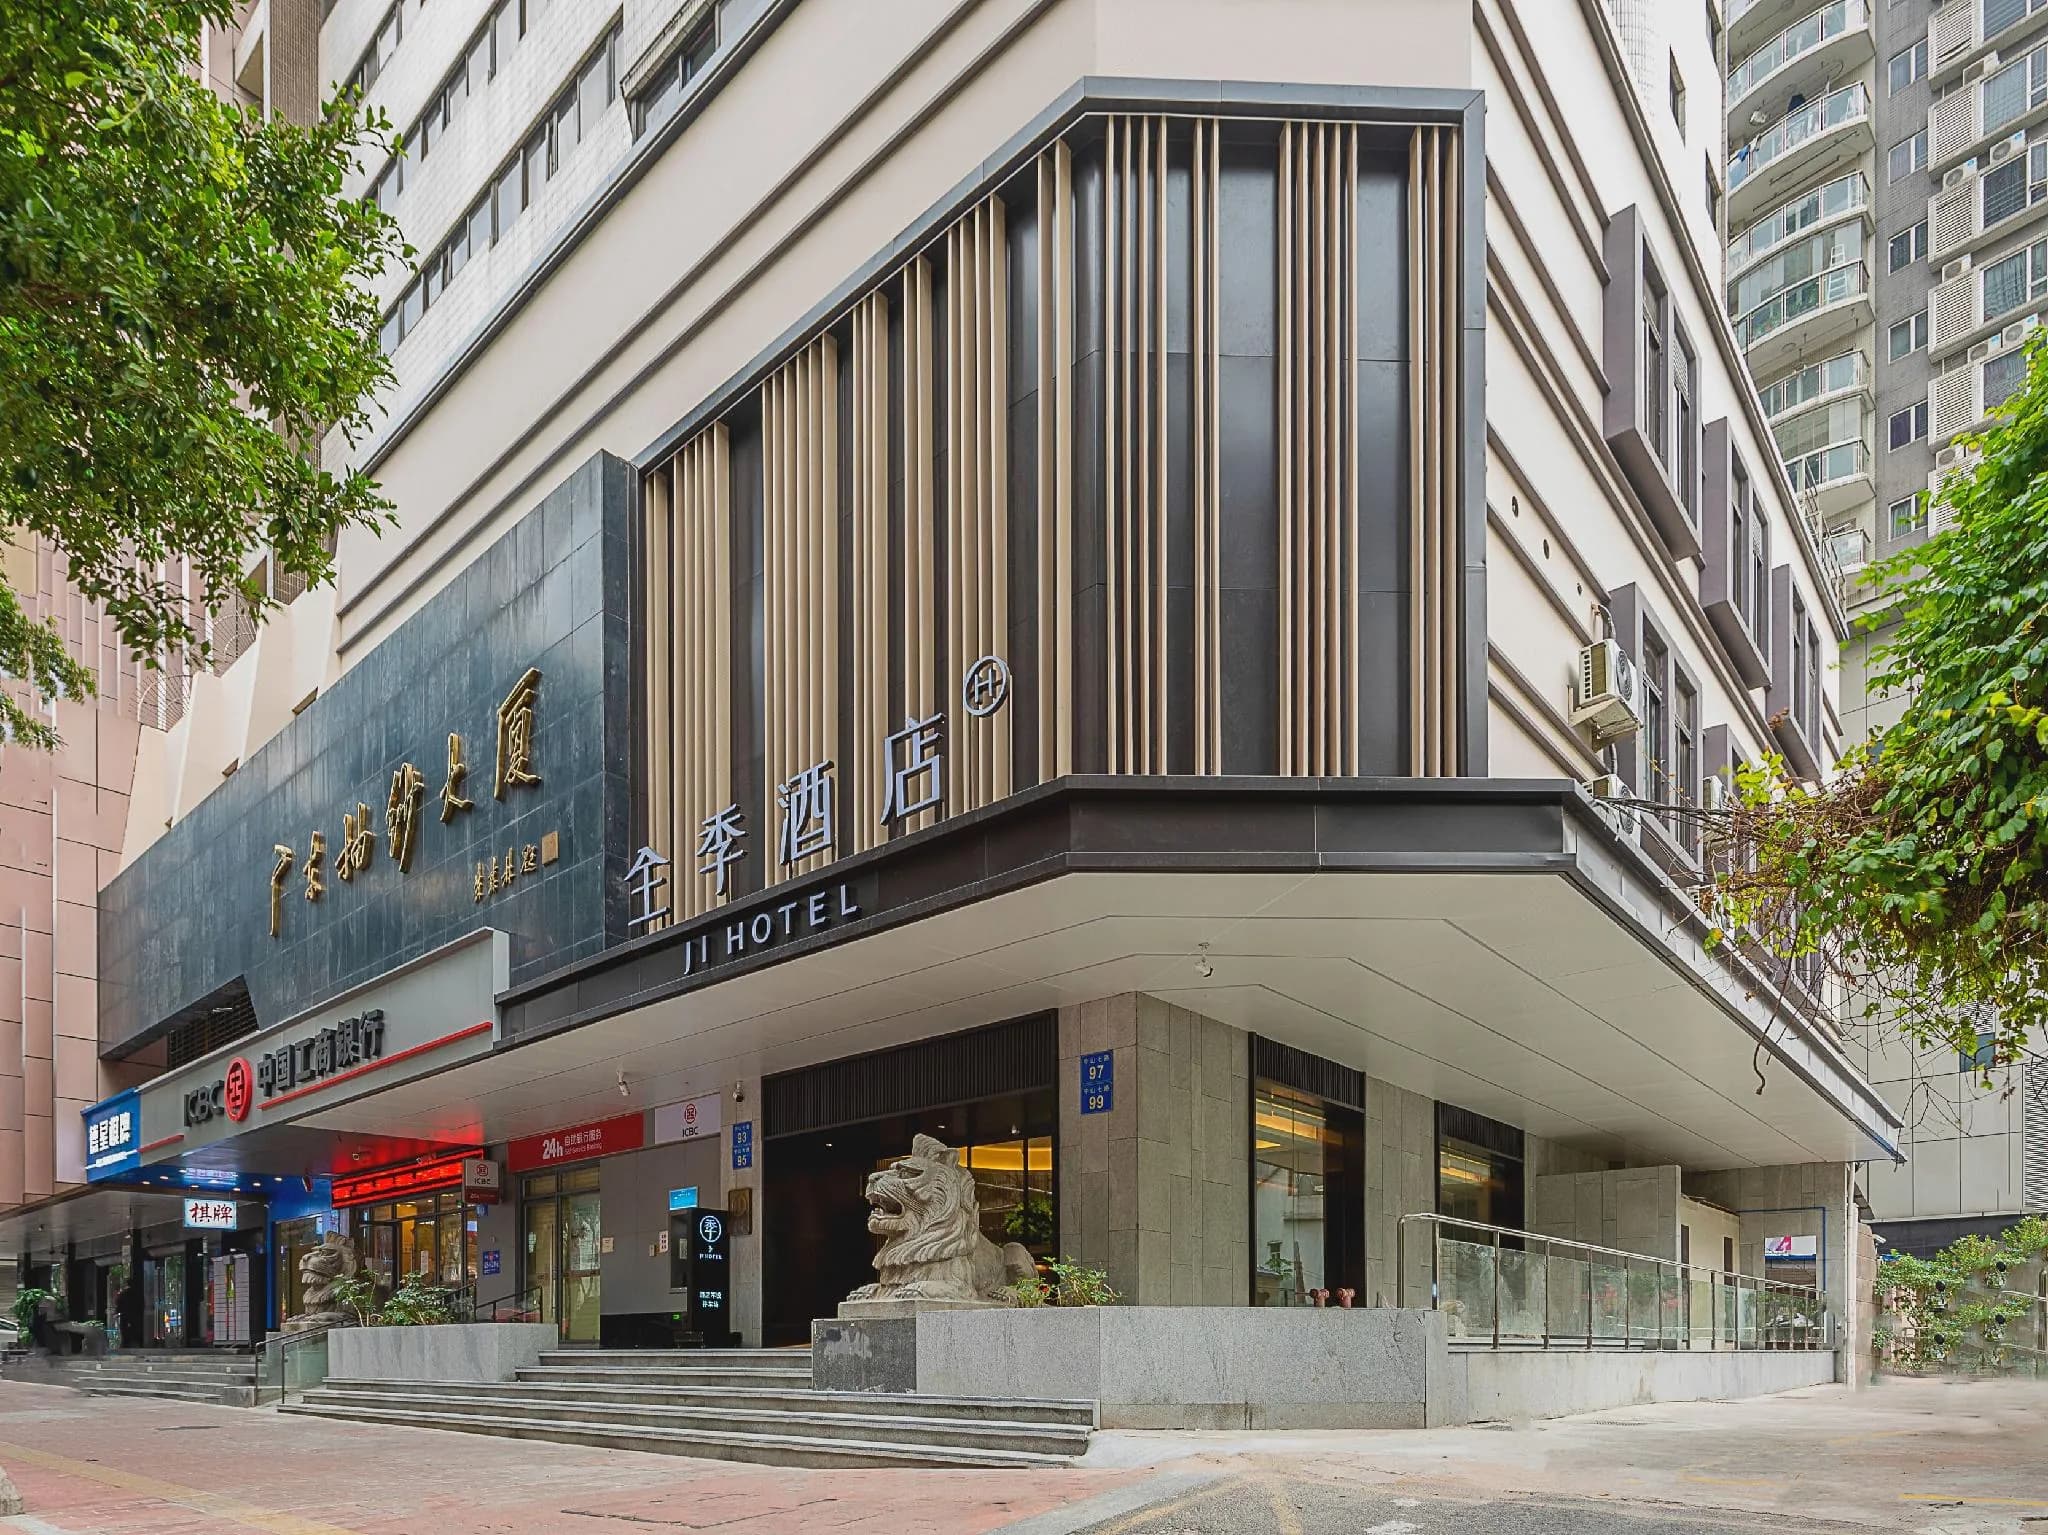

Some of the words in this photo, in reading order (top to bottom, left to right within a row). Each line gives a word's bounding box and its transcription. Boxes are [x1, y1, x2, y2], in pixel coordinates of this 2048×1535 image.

[624, 712, 946, 926] 全季酒店
[684, 935, 708, 974] JI
[727, 884, 860, 955] HOTEL
[257, 1009, 384, 1097] 中国工商银行
[1089, 1065, 1104, 1080] 97
[184, 1080, 225, 1127] ICBC
[1089, 1095, 1104, 1110] 99
[682, 1126, 699, 1137] ICBC
[737, 1131, 747, 1144] 93
[542, 1138, 564, 1159] 24h
[189, 1202, 233, 1225] 棋牌
